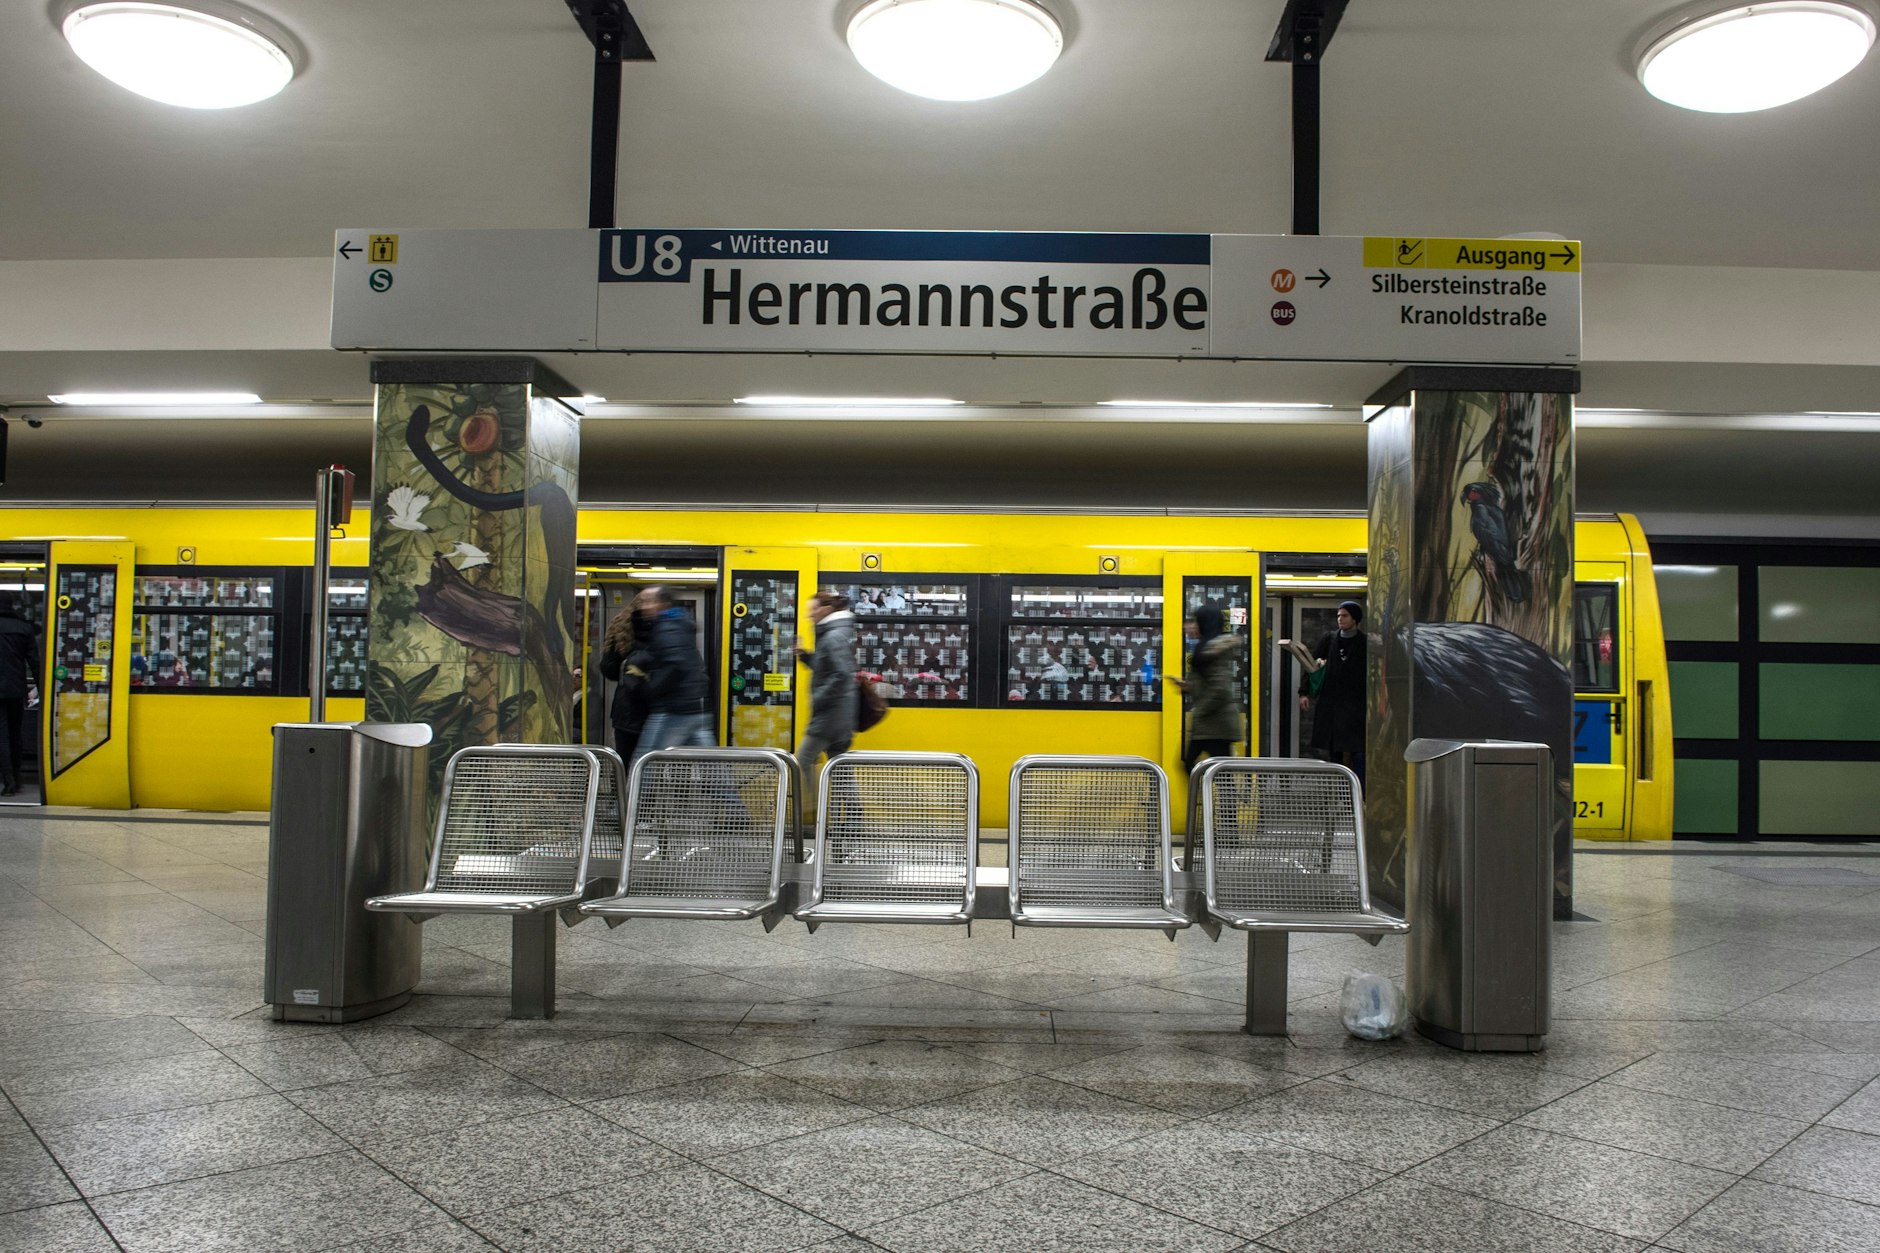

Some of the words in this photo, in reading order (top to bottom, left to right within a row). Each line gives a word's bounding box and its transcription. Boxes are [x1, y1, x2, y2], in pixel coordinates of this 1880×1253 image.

[611, 234, 683, 277] U8
[730, 235, 829, 256] Wittenau
[1457, 245, 1546, 271] Ausgang
[373, 270, 389, 291] S
[1273, 273, 1294, 288] M
[1372, 274, 1547, 296] Silbersteinstraße
[703, 267, 1207, 330] Hermannstraße
[1273, 308, 1295, 319] BUS
[1402, 305, 1547, 326] Kranoldstraße
